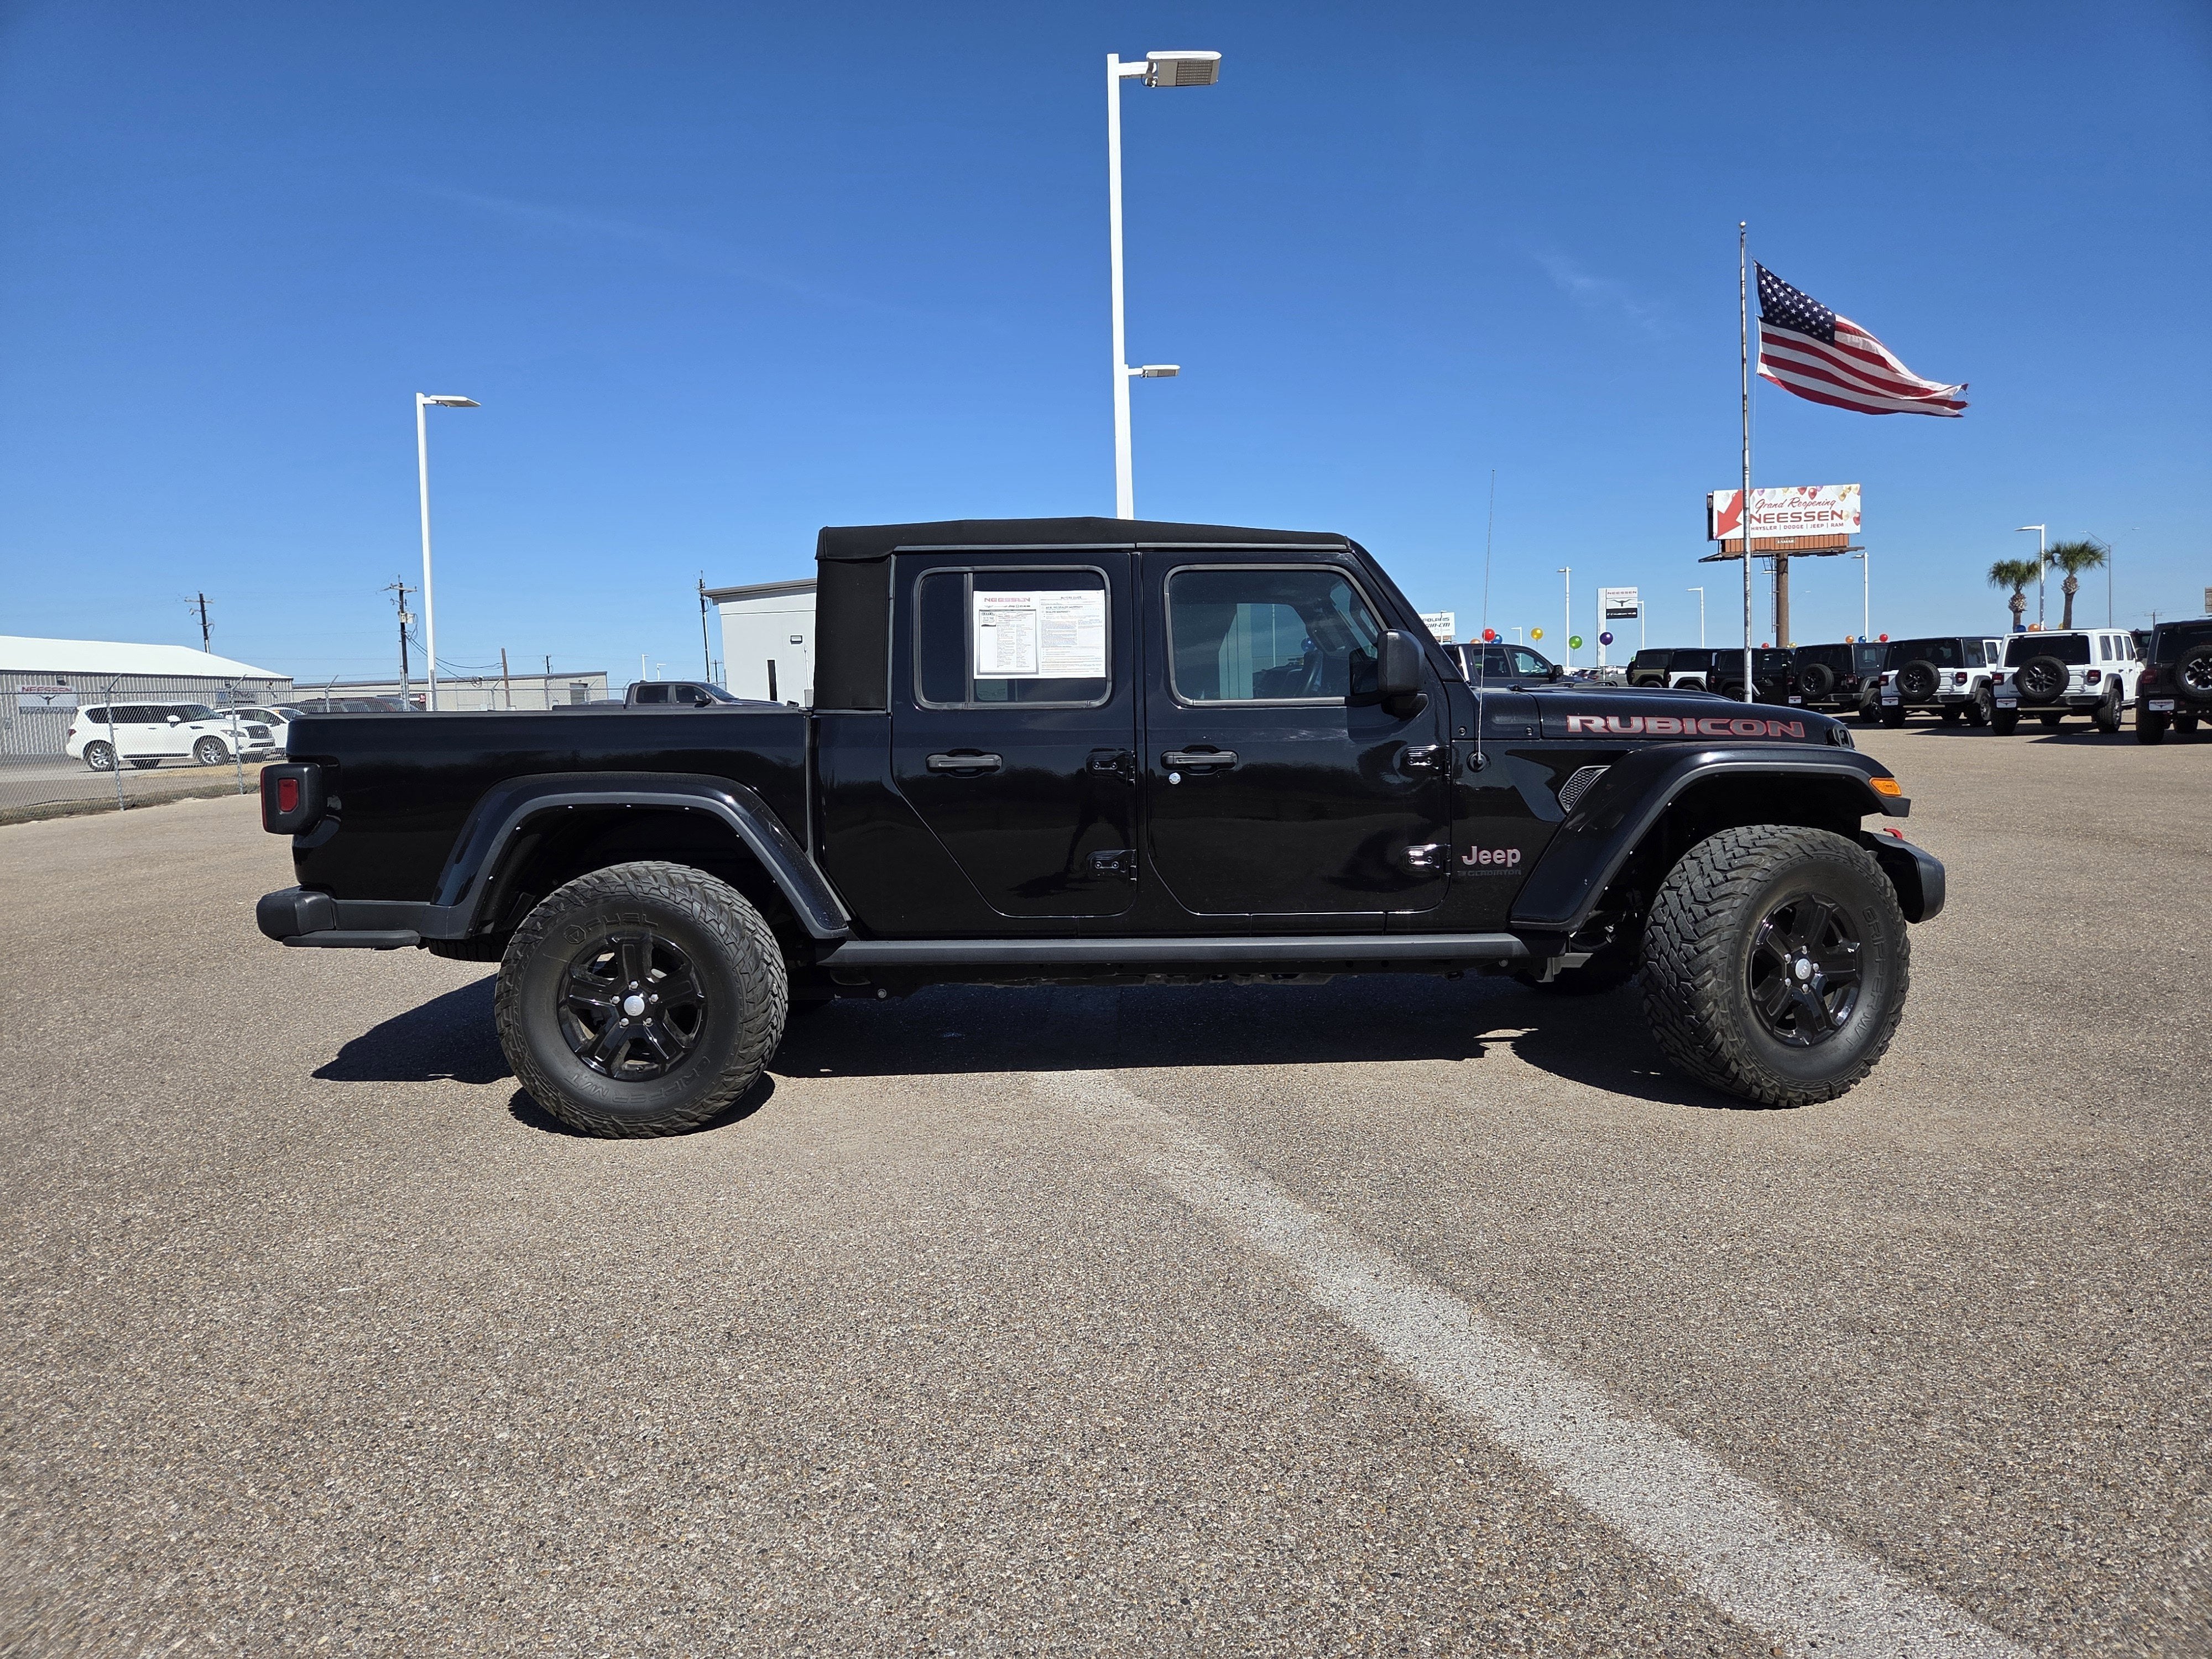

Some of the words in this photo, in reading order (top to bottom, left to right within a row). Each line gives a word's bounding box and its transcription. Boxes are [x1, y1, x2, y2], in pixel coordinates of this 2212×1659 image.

[1755, 499, 1787, 514] Grand
[1787, 497, 1836, 509] Reopening
[1749, 510, 1843, 524] NEESSEN
[1567, 716, 1805, 738] RUBICON
[1462, 846, 1521, 867] Jeep
[585, 913, 658, 933] FUEL
[1863, 906, 1885, 1010] GRIPPER
[1845, 1013, 1872, 1051] M/T
[565, 1074, 608, 1099] M/T
